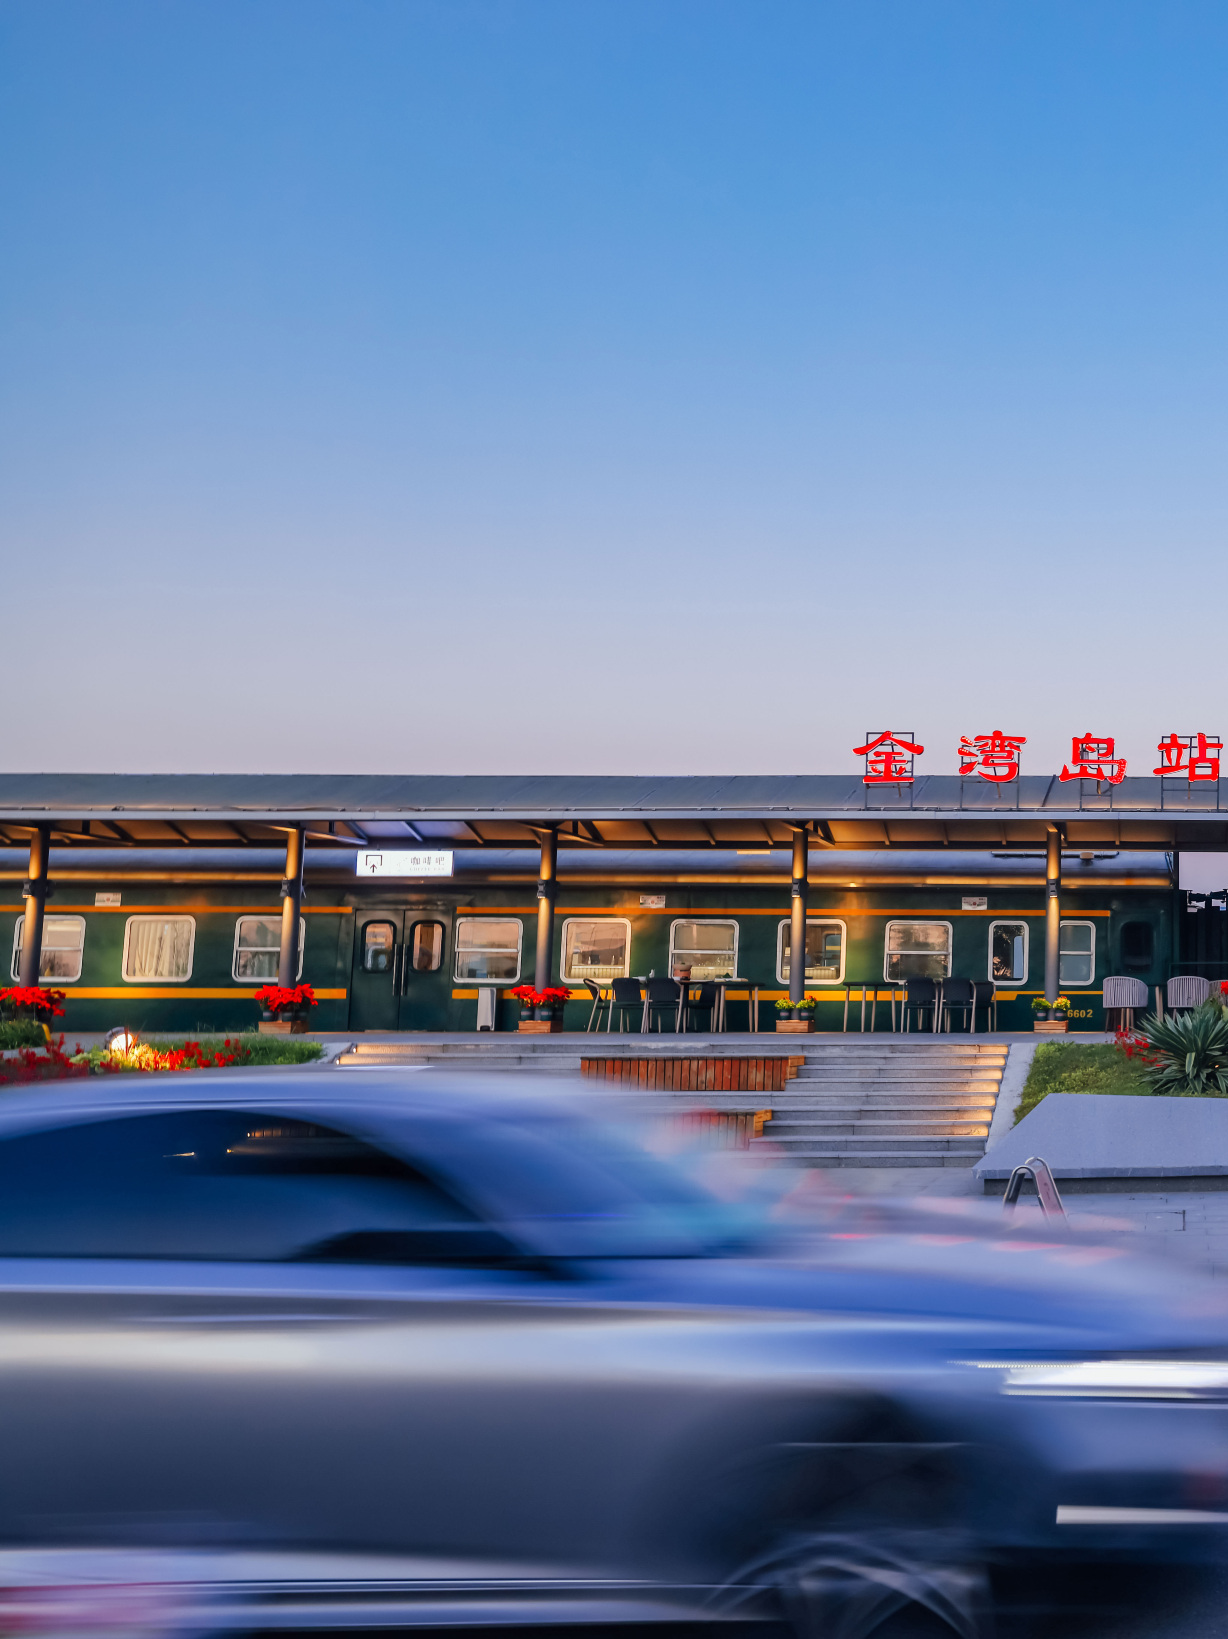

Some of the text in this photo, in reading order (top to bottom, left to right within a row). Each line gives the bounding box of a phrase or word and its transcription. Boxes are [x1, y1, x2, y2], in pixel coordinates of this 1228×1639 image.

[852, 730, 1224, 784] 金湾岛站
[1067, 1009, 1093, 1018] 6602
